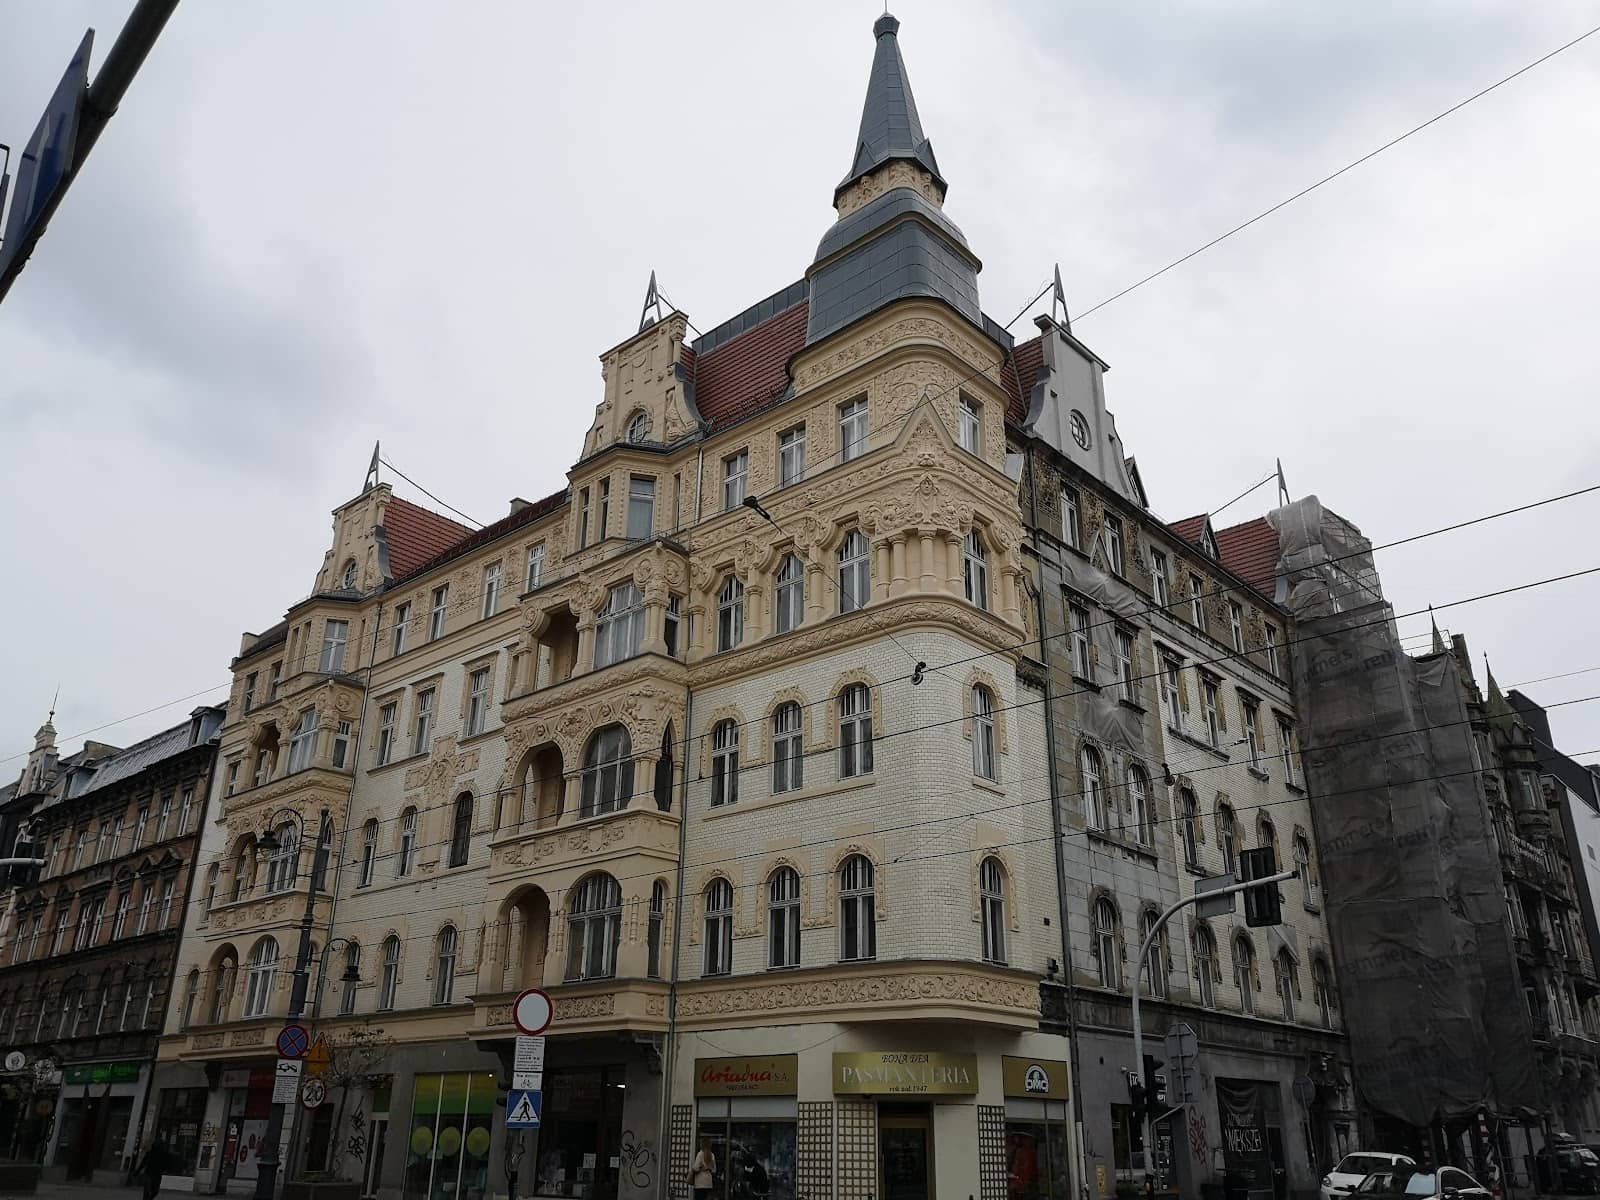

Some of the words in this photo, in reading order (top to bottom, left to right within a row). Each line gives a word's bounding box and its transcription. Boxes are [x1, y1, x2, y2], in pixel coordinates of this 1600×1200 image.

[881, 1054, 908, 1064] BONA
[910, 1053, 930, 1064] DEA
[841, 1065, 971, 1085] PASMANTERIA
